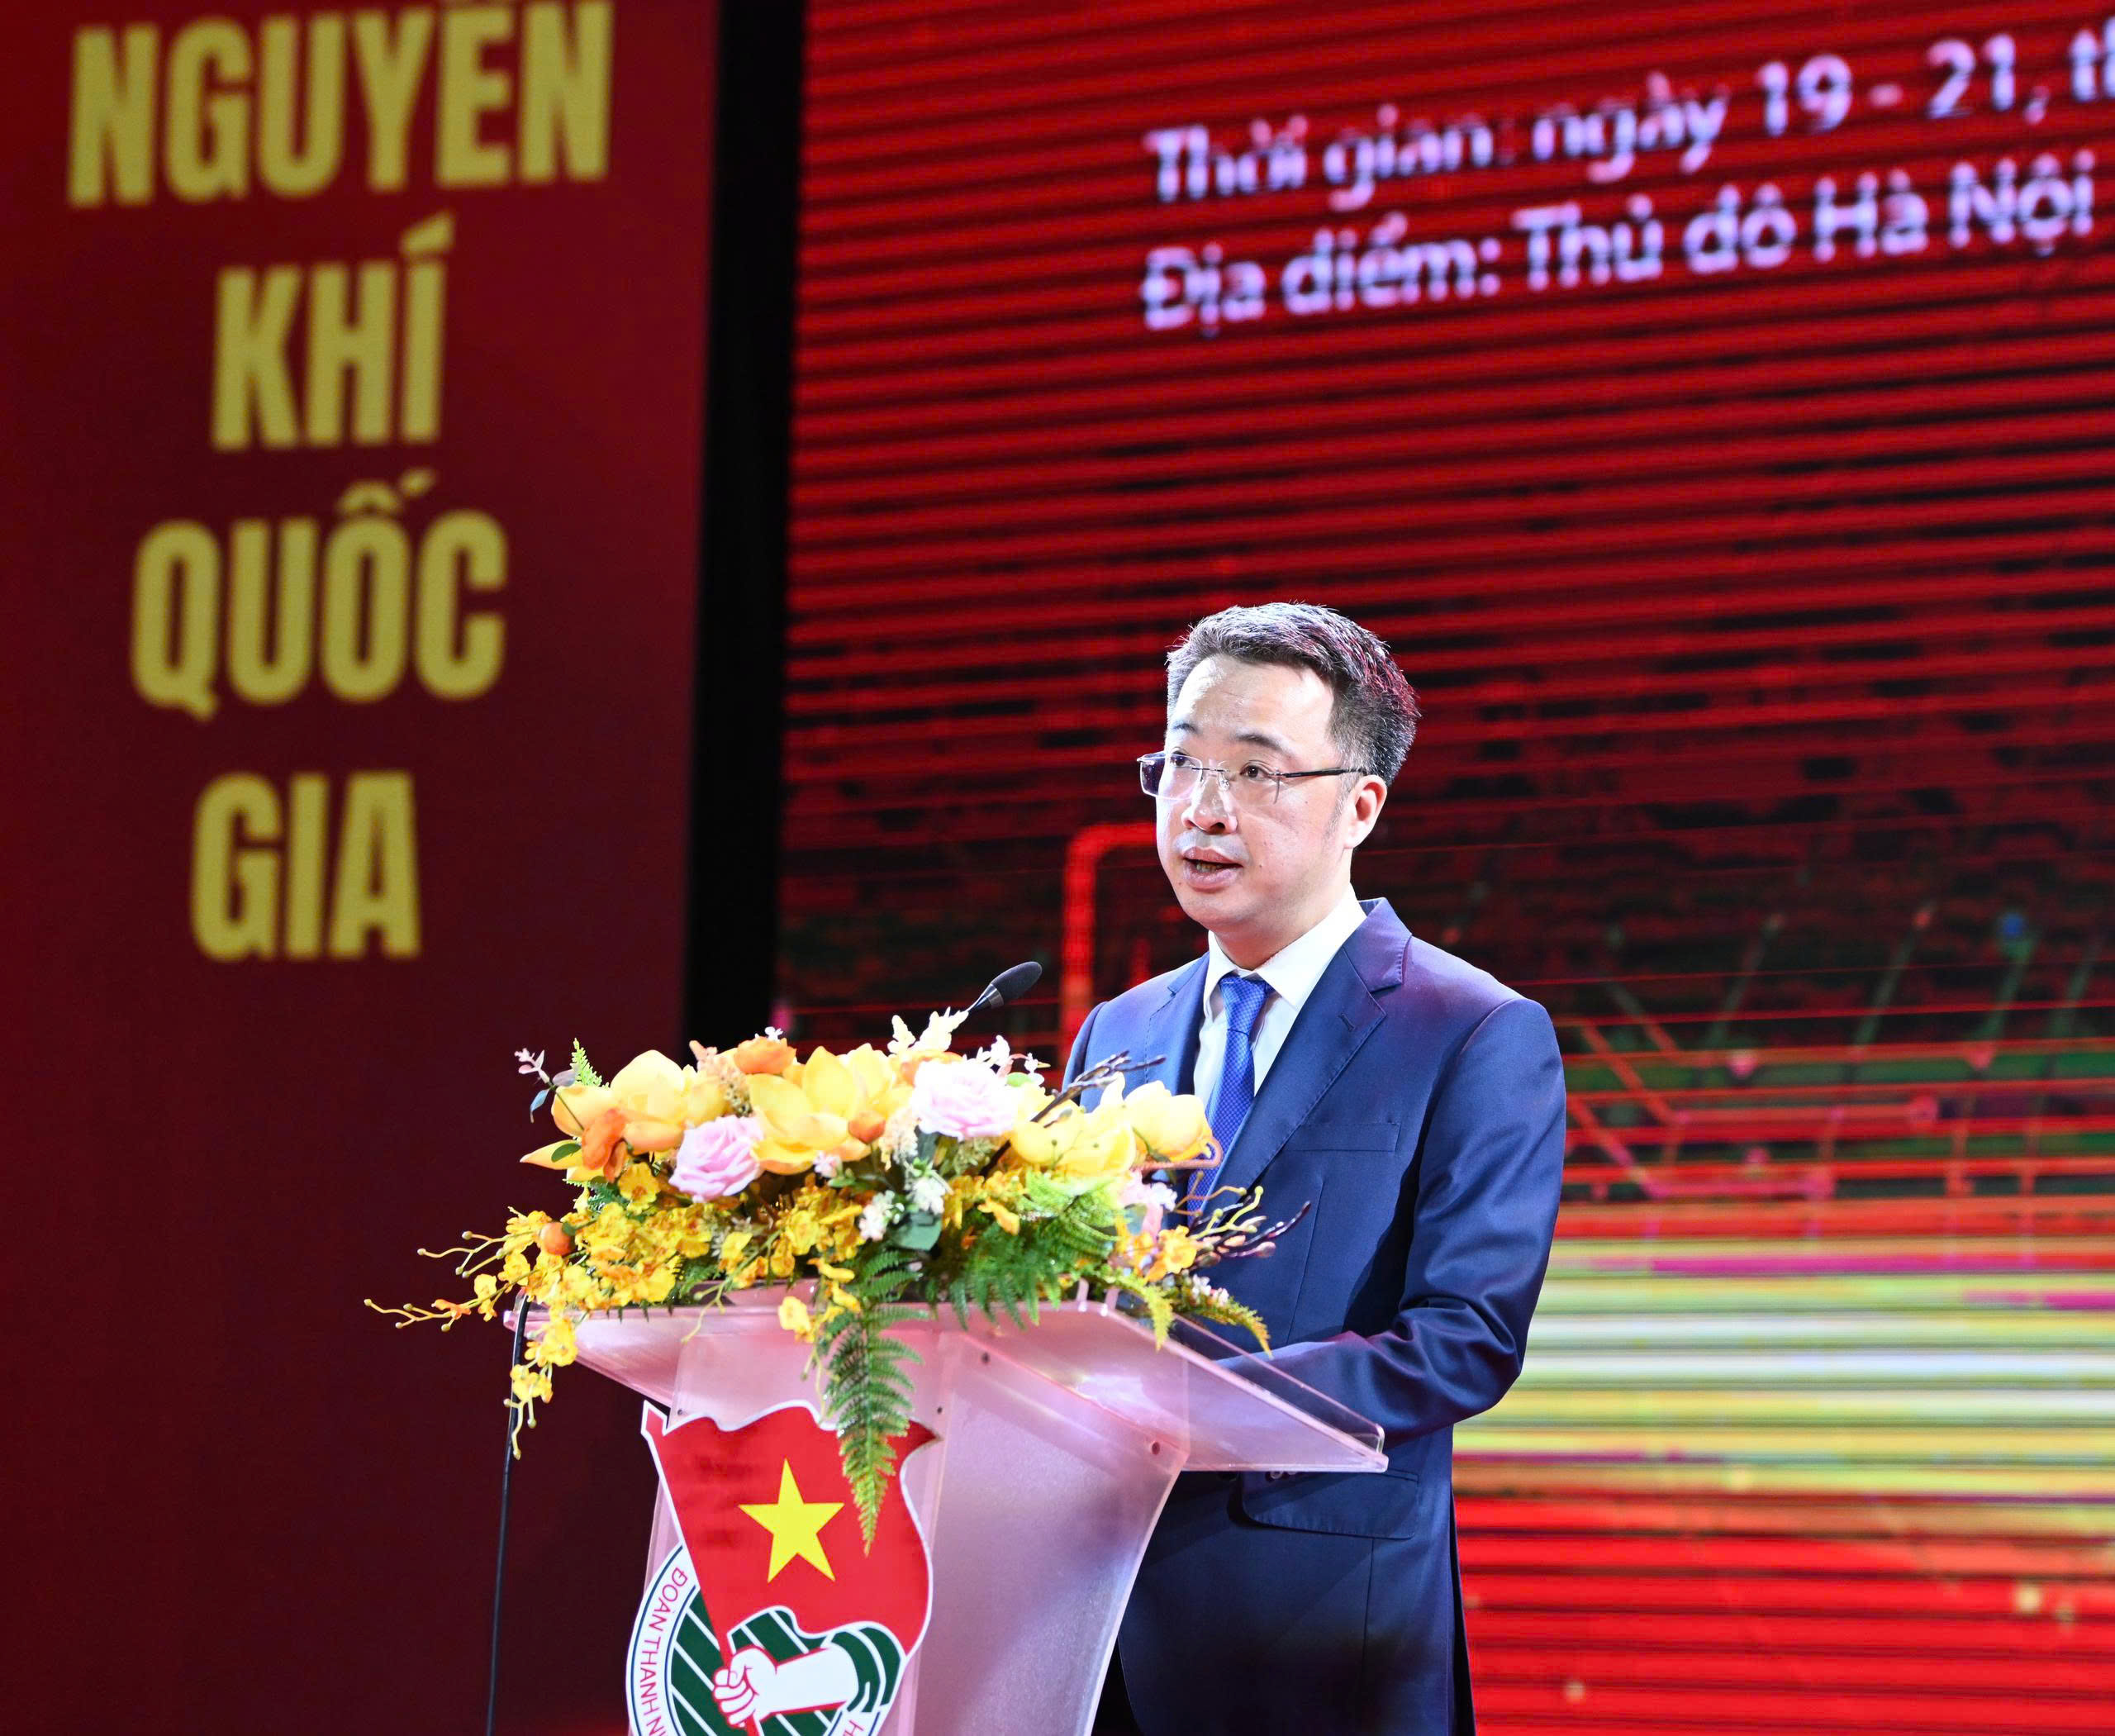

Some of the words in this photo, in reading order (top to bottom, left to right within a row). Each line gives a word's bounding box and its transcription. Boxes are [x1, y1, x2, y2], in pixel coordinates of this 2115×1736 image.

[1757, 55, 1853, 138] 19
[212, 212, 454, 449] KHÍ
[131, 468, 507, 719] QUỐC
[191, 770, 420, 961] GIA
[639, 1636, 661, 1716] THANH
